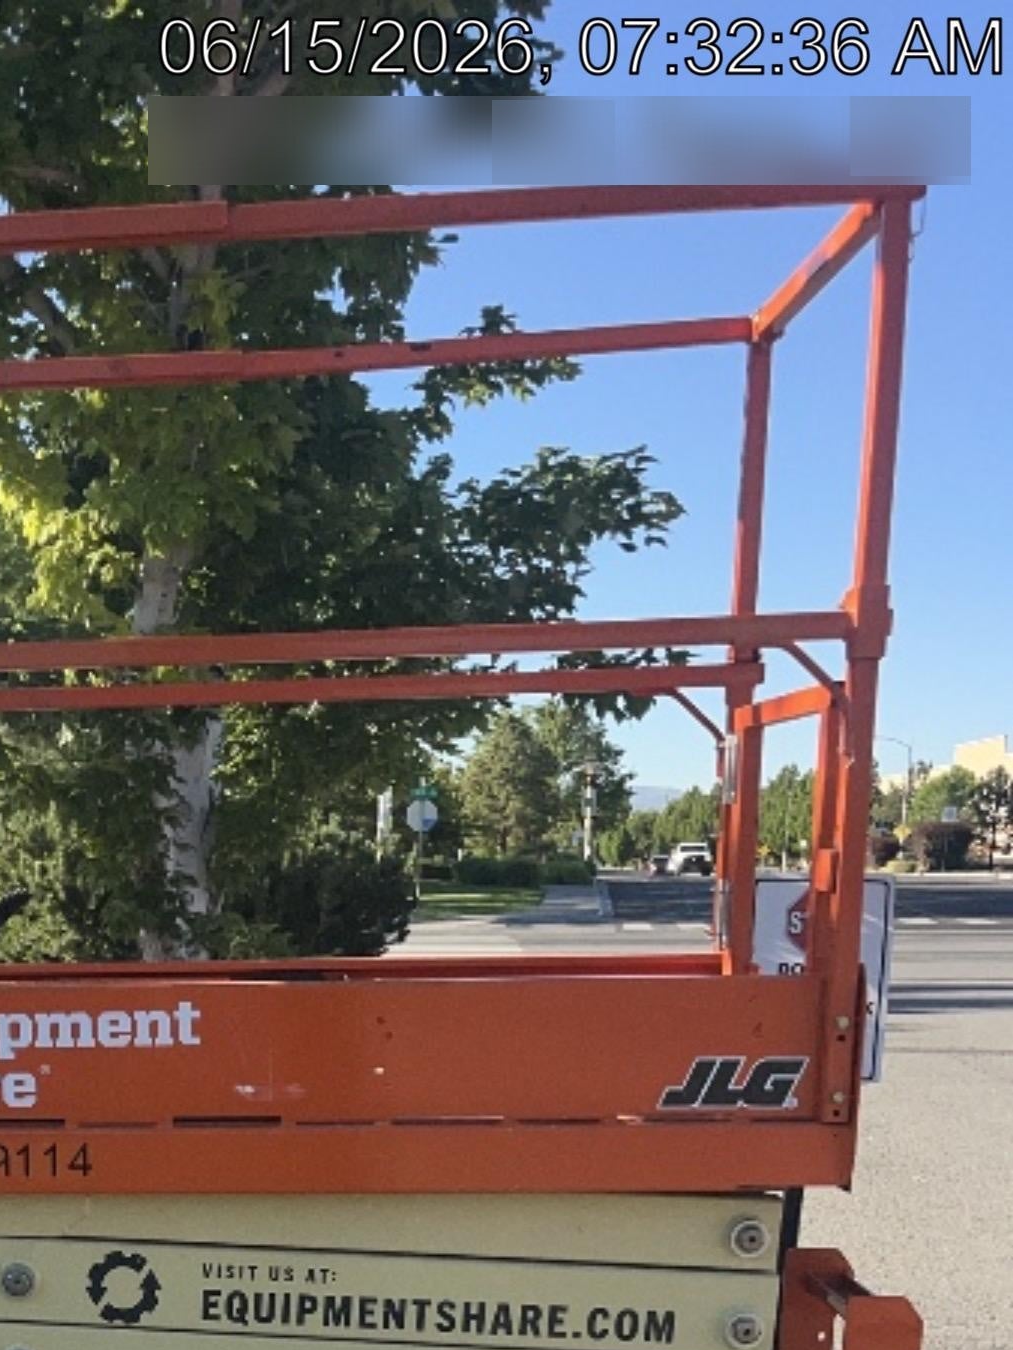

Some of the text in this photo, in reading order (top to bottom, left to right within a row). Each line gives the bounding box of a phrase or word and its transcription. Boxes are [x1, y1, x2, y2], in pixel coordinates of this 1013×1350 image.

[656, 1056, 810, 1110] JLG
[201, 1262, 338, 1285] VISIT US AT:
[200, 1289, 677, 1345] EQUIPMENTSHARE.COM
